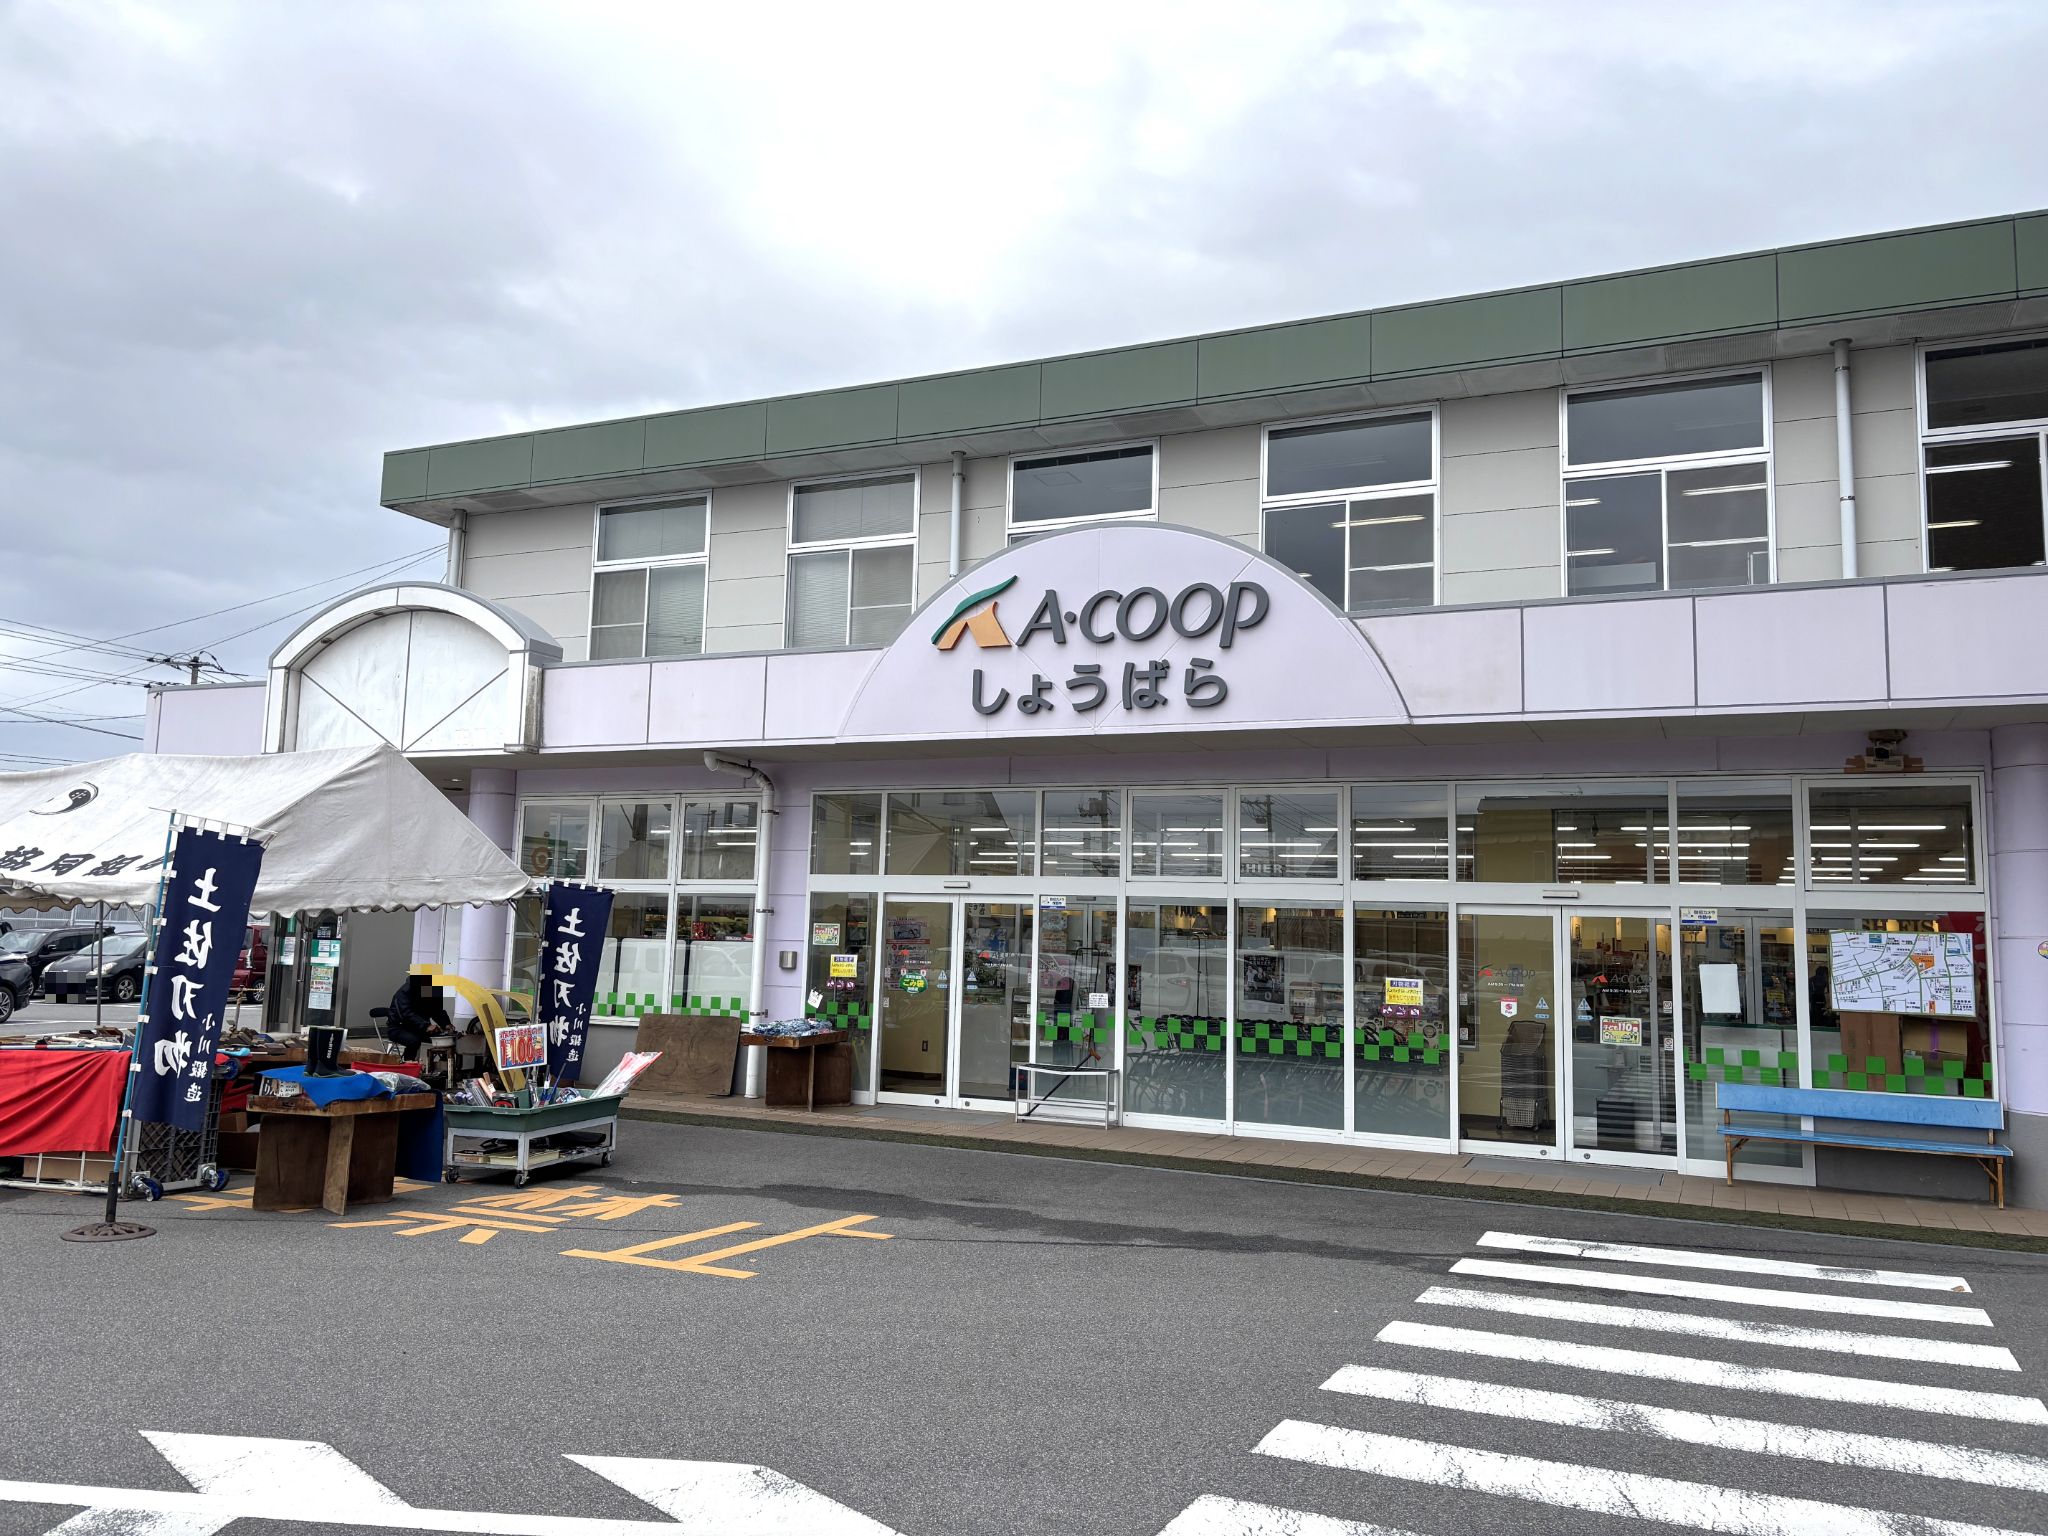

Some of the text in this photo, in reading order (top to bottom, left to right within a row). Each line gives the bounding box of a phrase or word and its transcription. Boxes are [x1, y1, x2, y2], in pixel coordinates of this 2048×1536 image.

[972, 657, 1228, 715] しょうばら
